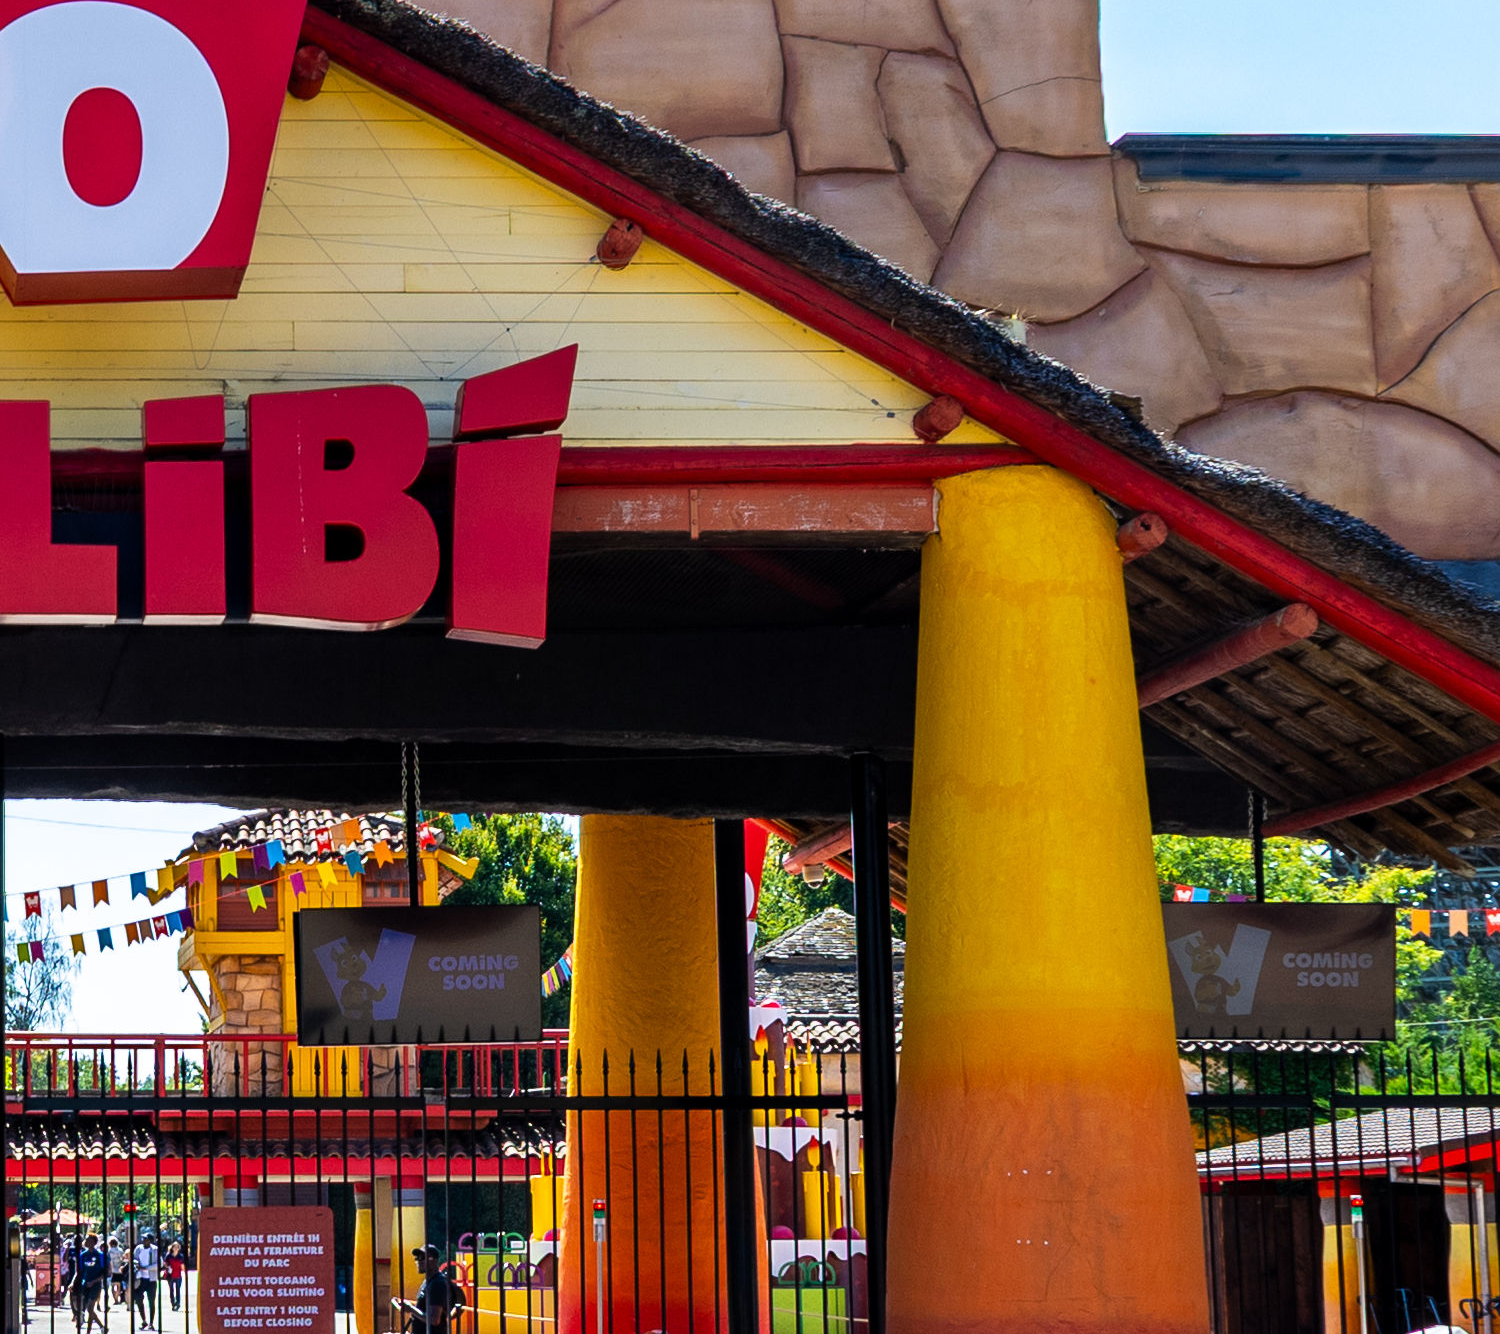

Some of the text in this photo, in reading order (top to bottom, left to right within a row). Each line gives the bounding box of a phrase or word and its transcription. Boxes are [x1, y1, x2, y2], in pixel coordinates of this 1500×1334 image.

[442, 973, 505, 991] SOON
[1296, 970, 1360, 988] SOON
[267, 1232, 305, 1244] ENTRÉE
[308, 1234, 320, 1243] 1H
[210, 1246, 324, 1256] AVANT LA FERMETURE
[245, 1259, 290, 1268] DU PARC
[219, 1276, 316, 1286] LAATSTE TOEGANG
[218, 1289, 240, 1298] UUR
[243, 1289, 274, 1298] VOOR
[217, 1307, 243, 1316] LAST
[245, 1306, 278, 1316] ENTRY
[288, 1306, 319, 1315] HOUR
[224, 1319, 264, 1328] BEFORE
